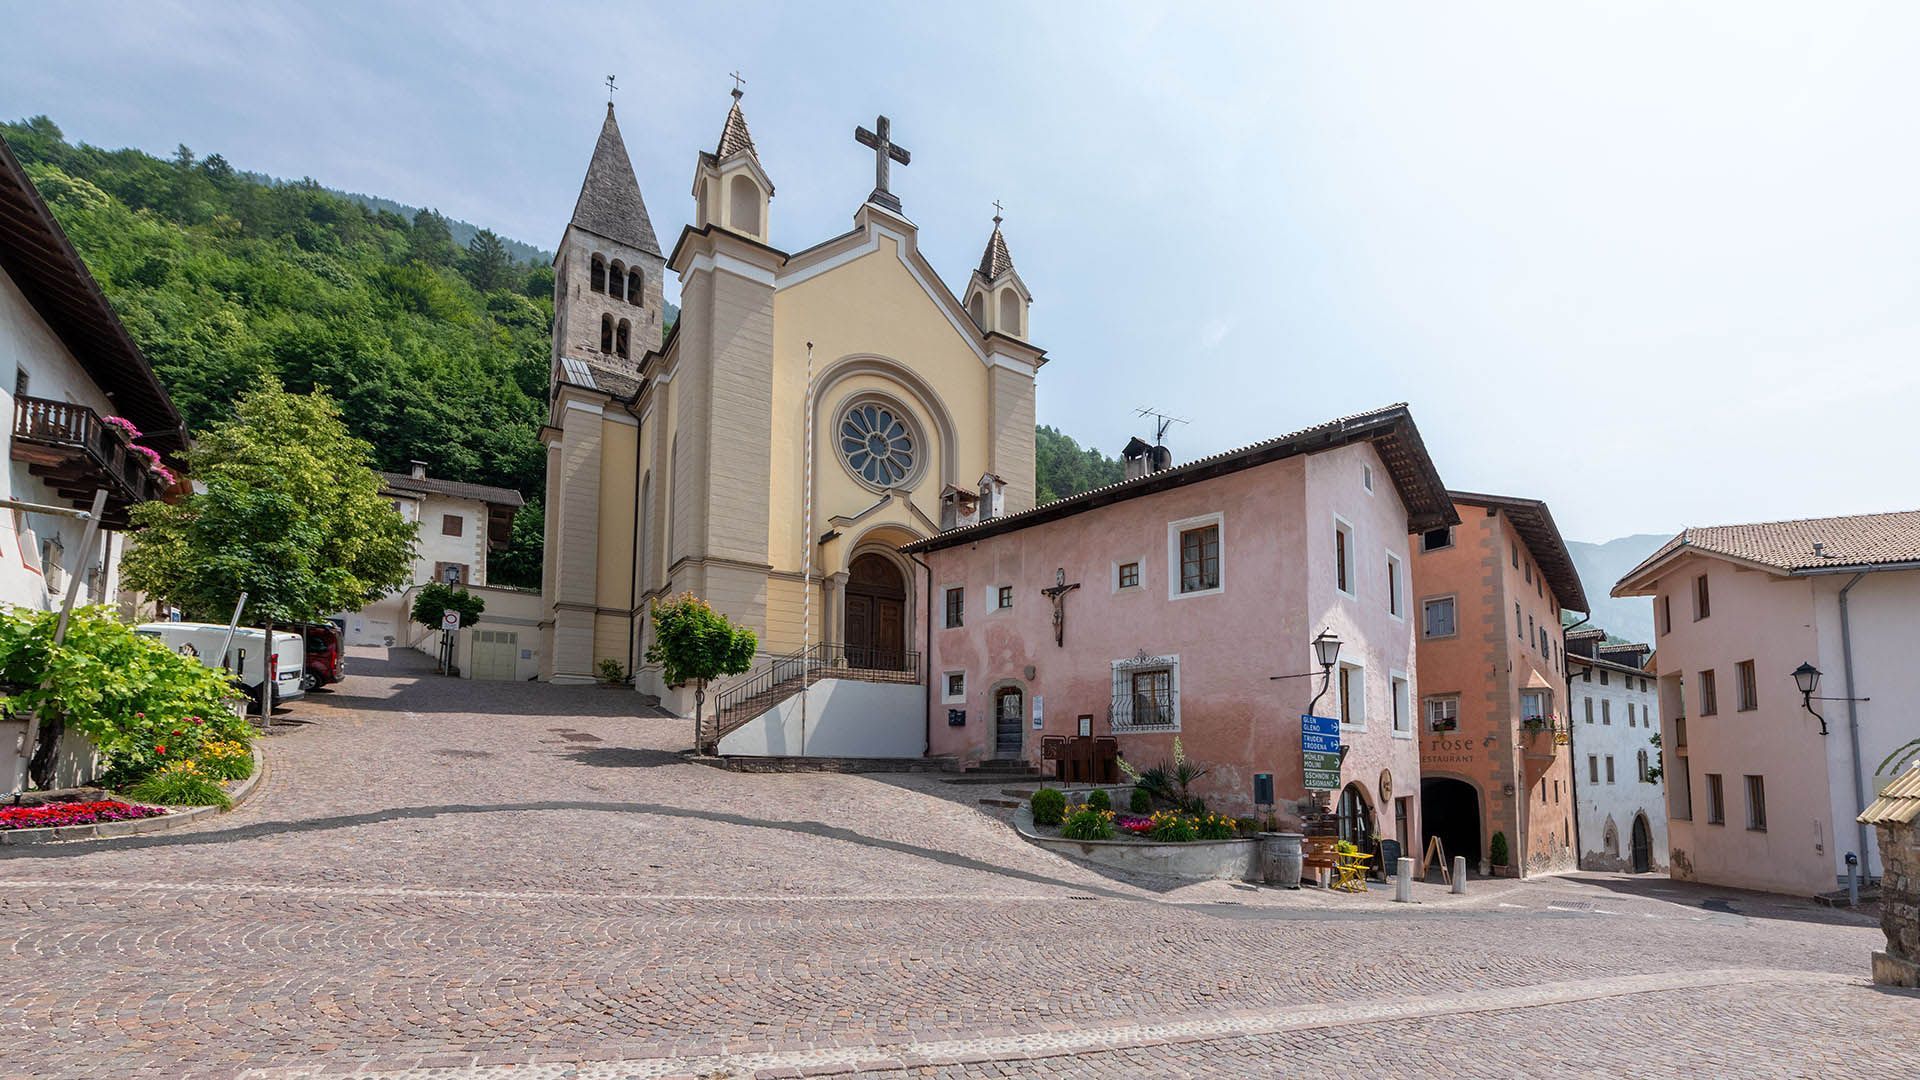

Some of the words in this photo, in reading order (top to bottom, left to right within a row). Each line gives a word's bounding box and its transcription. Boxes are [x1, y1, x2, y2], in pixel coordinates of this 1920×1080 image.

[1303, 724, 1321, 732] GLENO
[1304, 742, 1327, 750] TRODENA
[1432, 739, 1473, 751] rose
[1422, 755, 1473, 763] ESTAURANT
